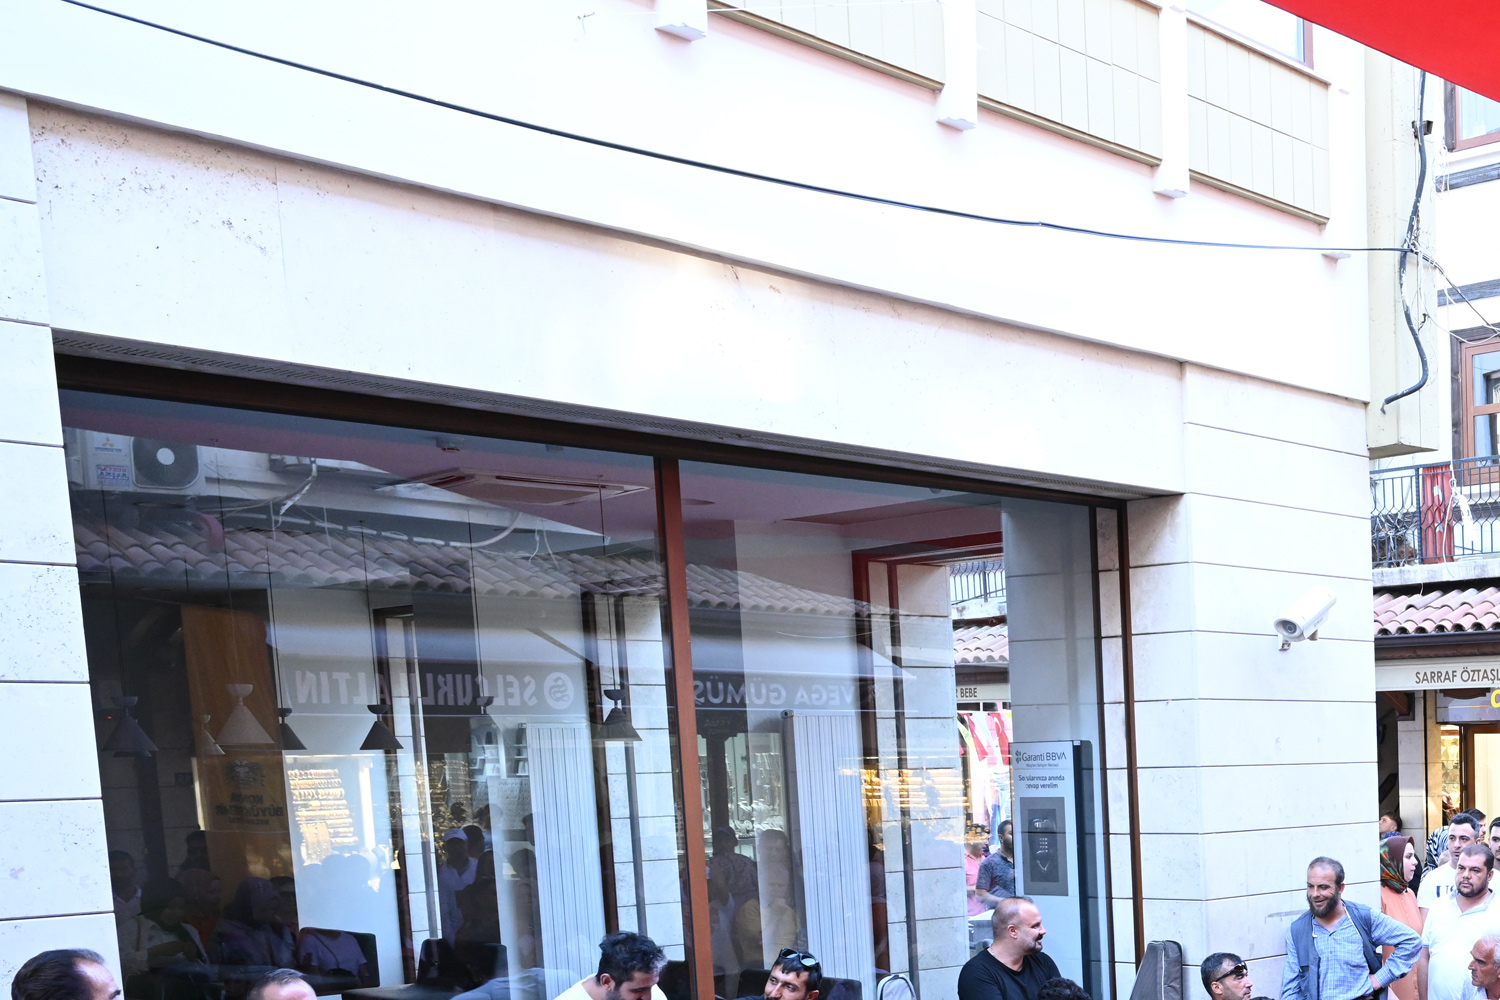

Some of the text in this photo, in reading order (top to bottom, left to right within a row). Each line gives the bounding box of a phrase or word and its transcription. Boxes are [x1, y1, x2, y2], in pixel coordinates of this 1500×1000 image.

[1415, 671, 1458, 685] SARRAF
[960, 687, 978, 698] BEBE
[1021, 751, 1067, 762] Garanti BBVA
